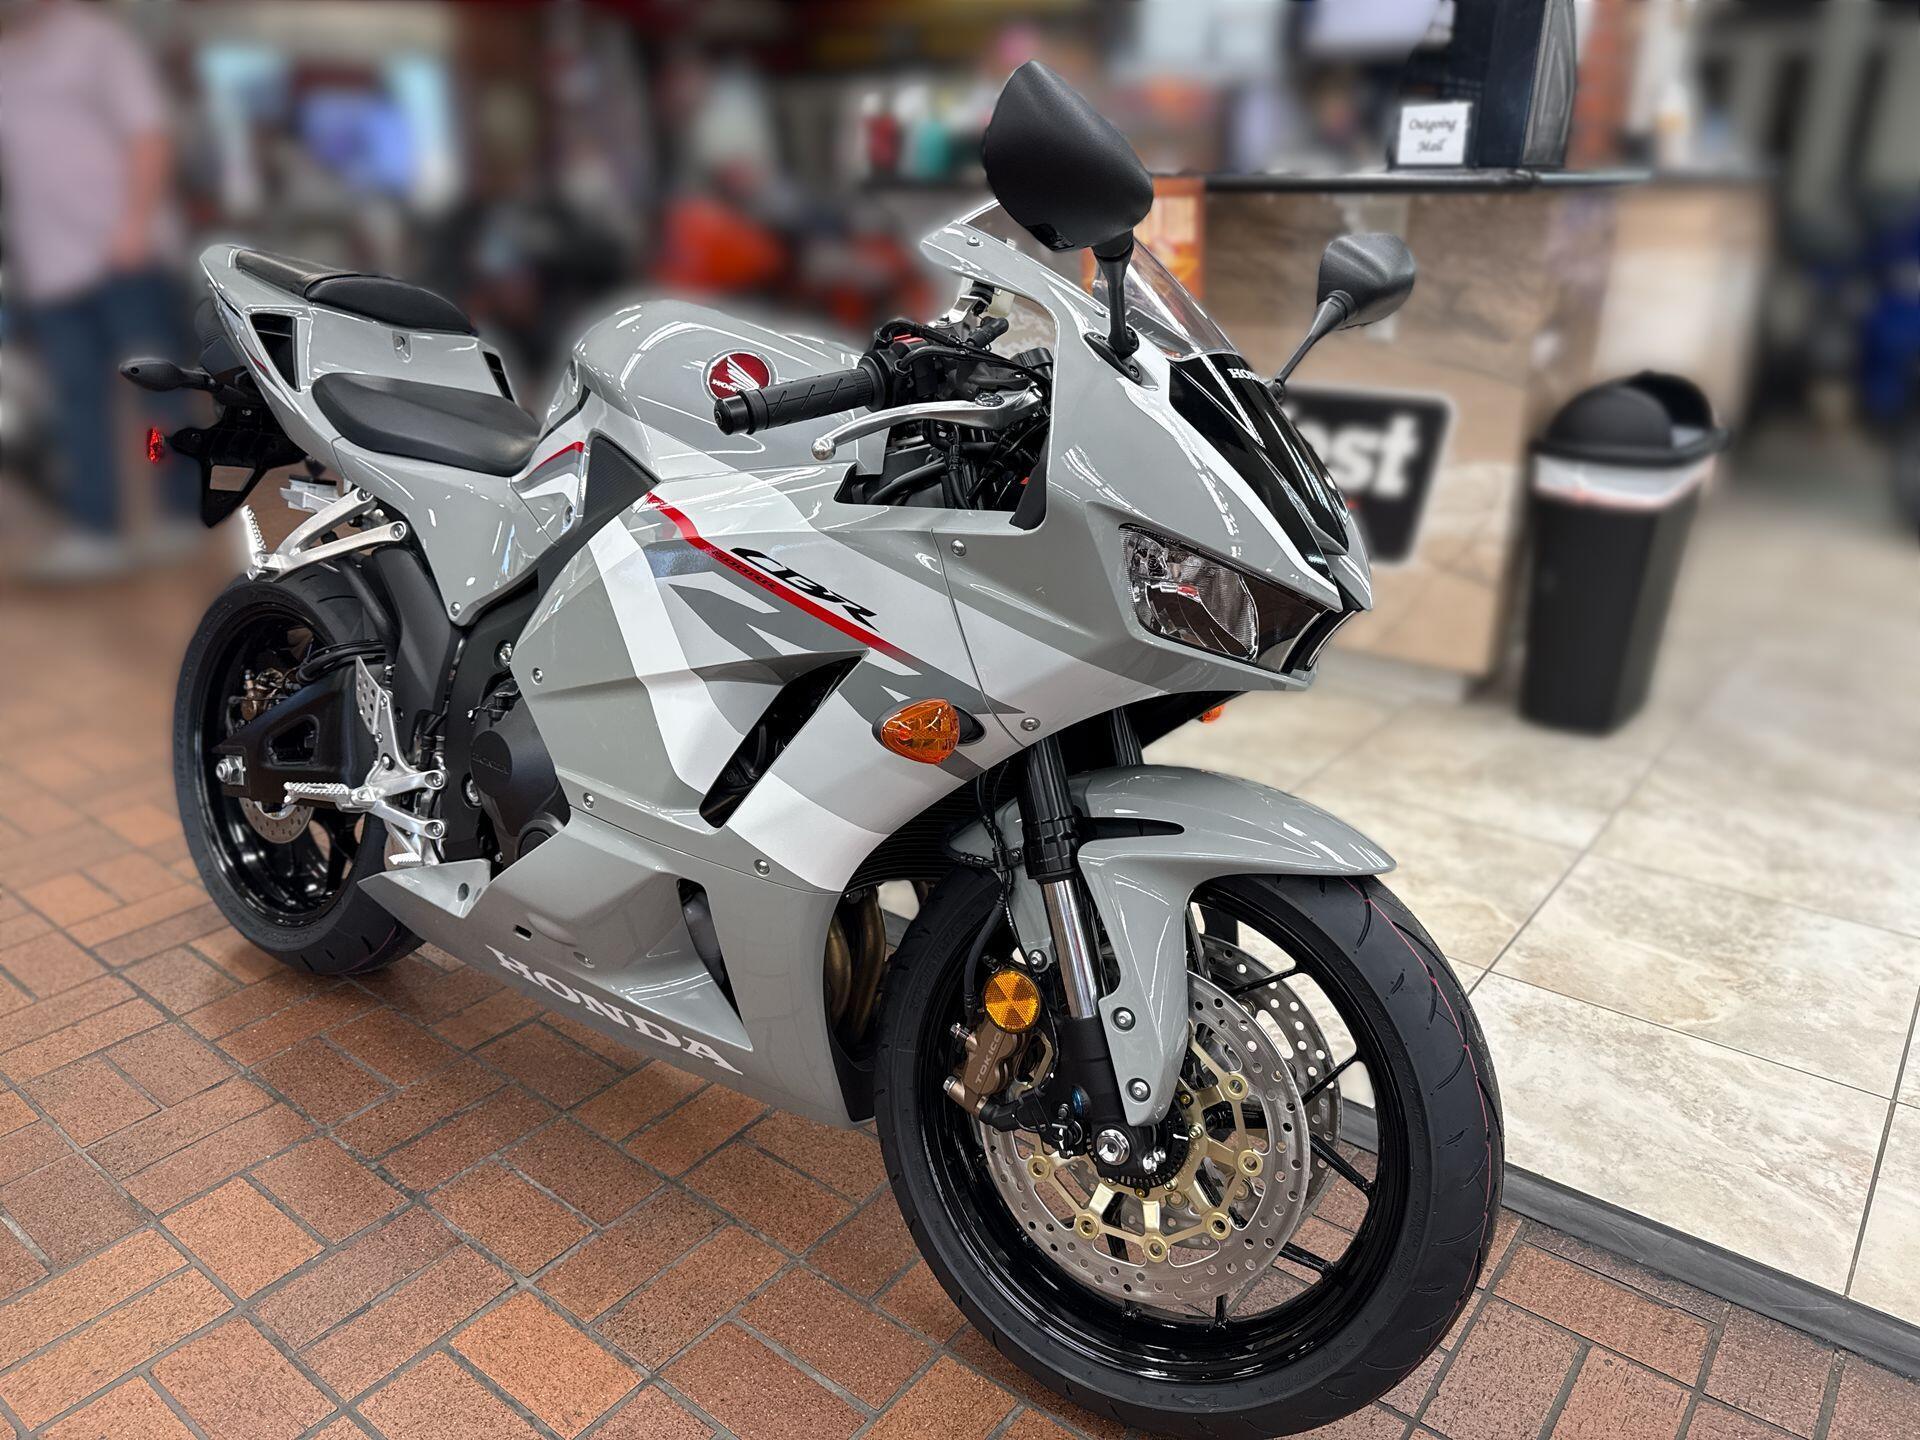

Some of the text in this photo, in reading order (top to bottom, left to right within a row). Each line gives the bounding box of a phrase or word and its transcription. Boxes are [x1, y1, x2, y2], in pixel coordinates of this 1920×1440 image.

[730, 547, 880, 634] CBR
[484, 944, 743, 1075] HONDA
[975, 1032, 1002, 1084] TOKICO
